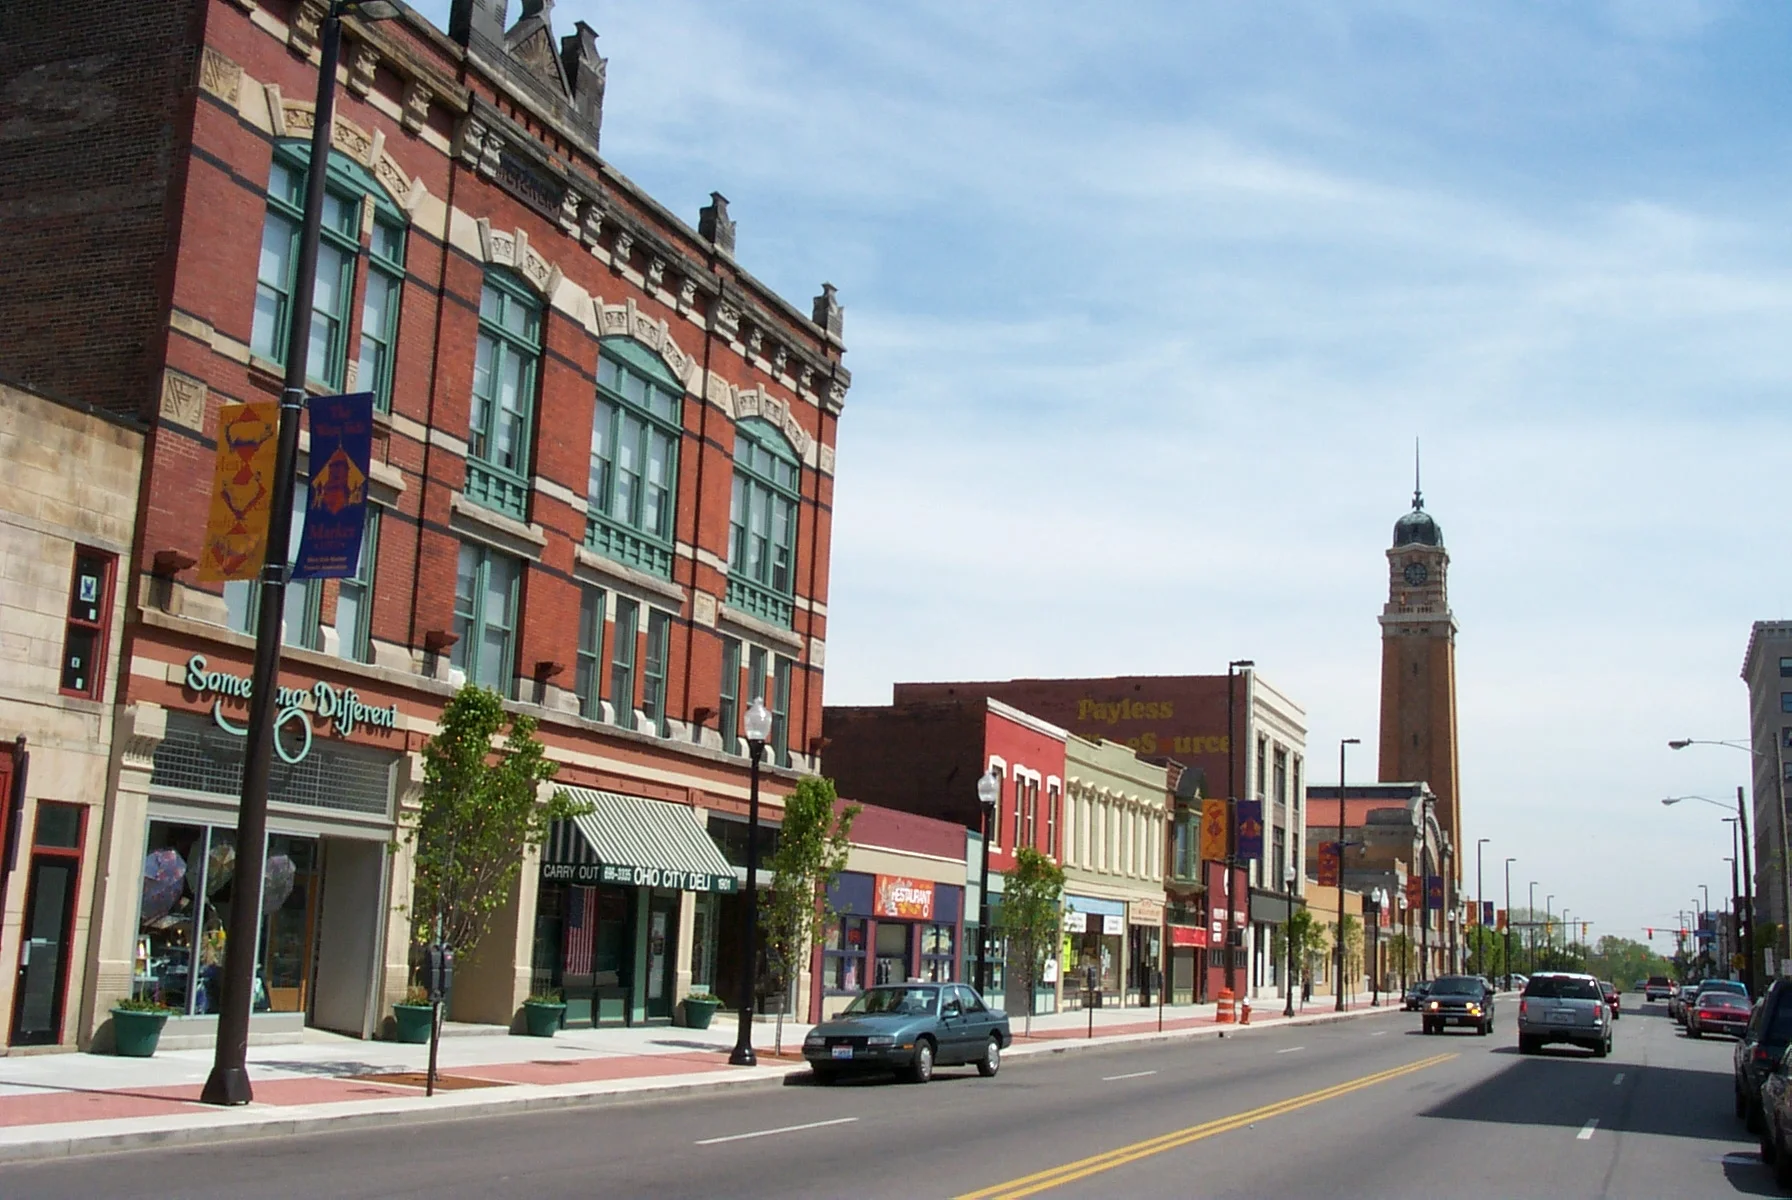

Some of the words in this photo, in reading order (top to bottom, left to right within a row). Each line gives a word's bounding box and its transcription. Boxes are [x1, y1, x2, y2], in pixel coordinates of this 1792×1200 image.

[314, 681, 400, 737] Different
[1077, 698, 1174, 725] Payless
[543, 864, 575, 880] CARRY
[579, 865, 600, 880] OUT
[633, 867, 660, 888] OHIO
[662, 871, 686, 889] CITY
[689, 874, 711, 891] DELI
